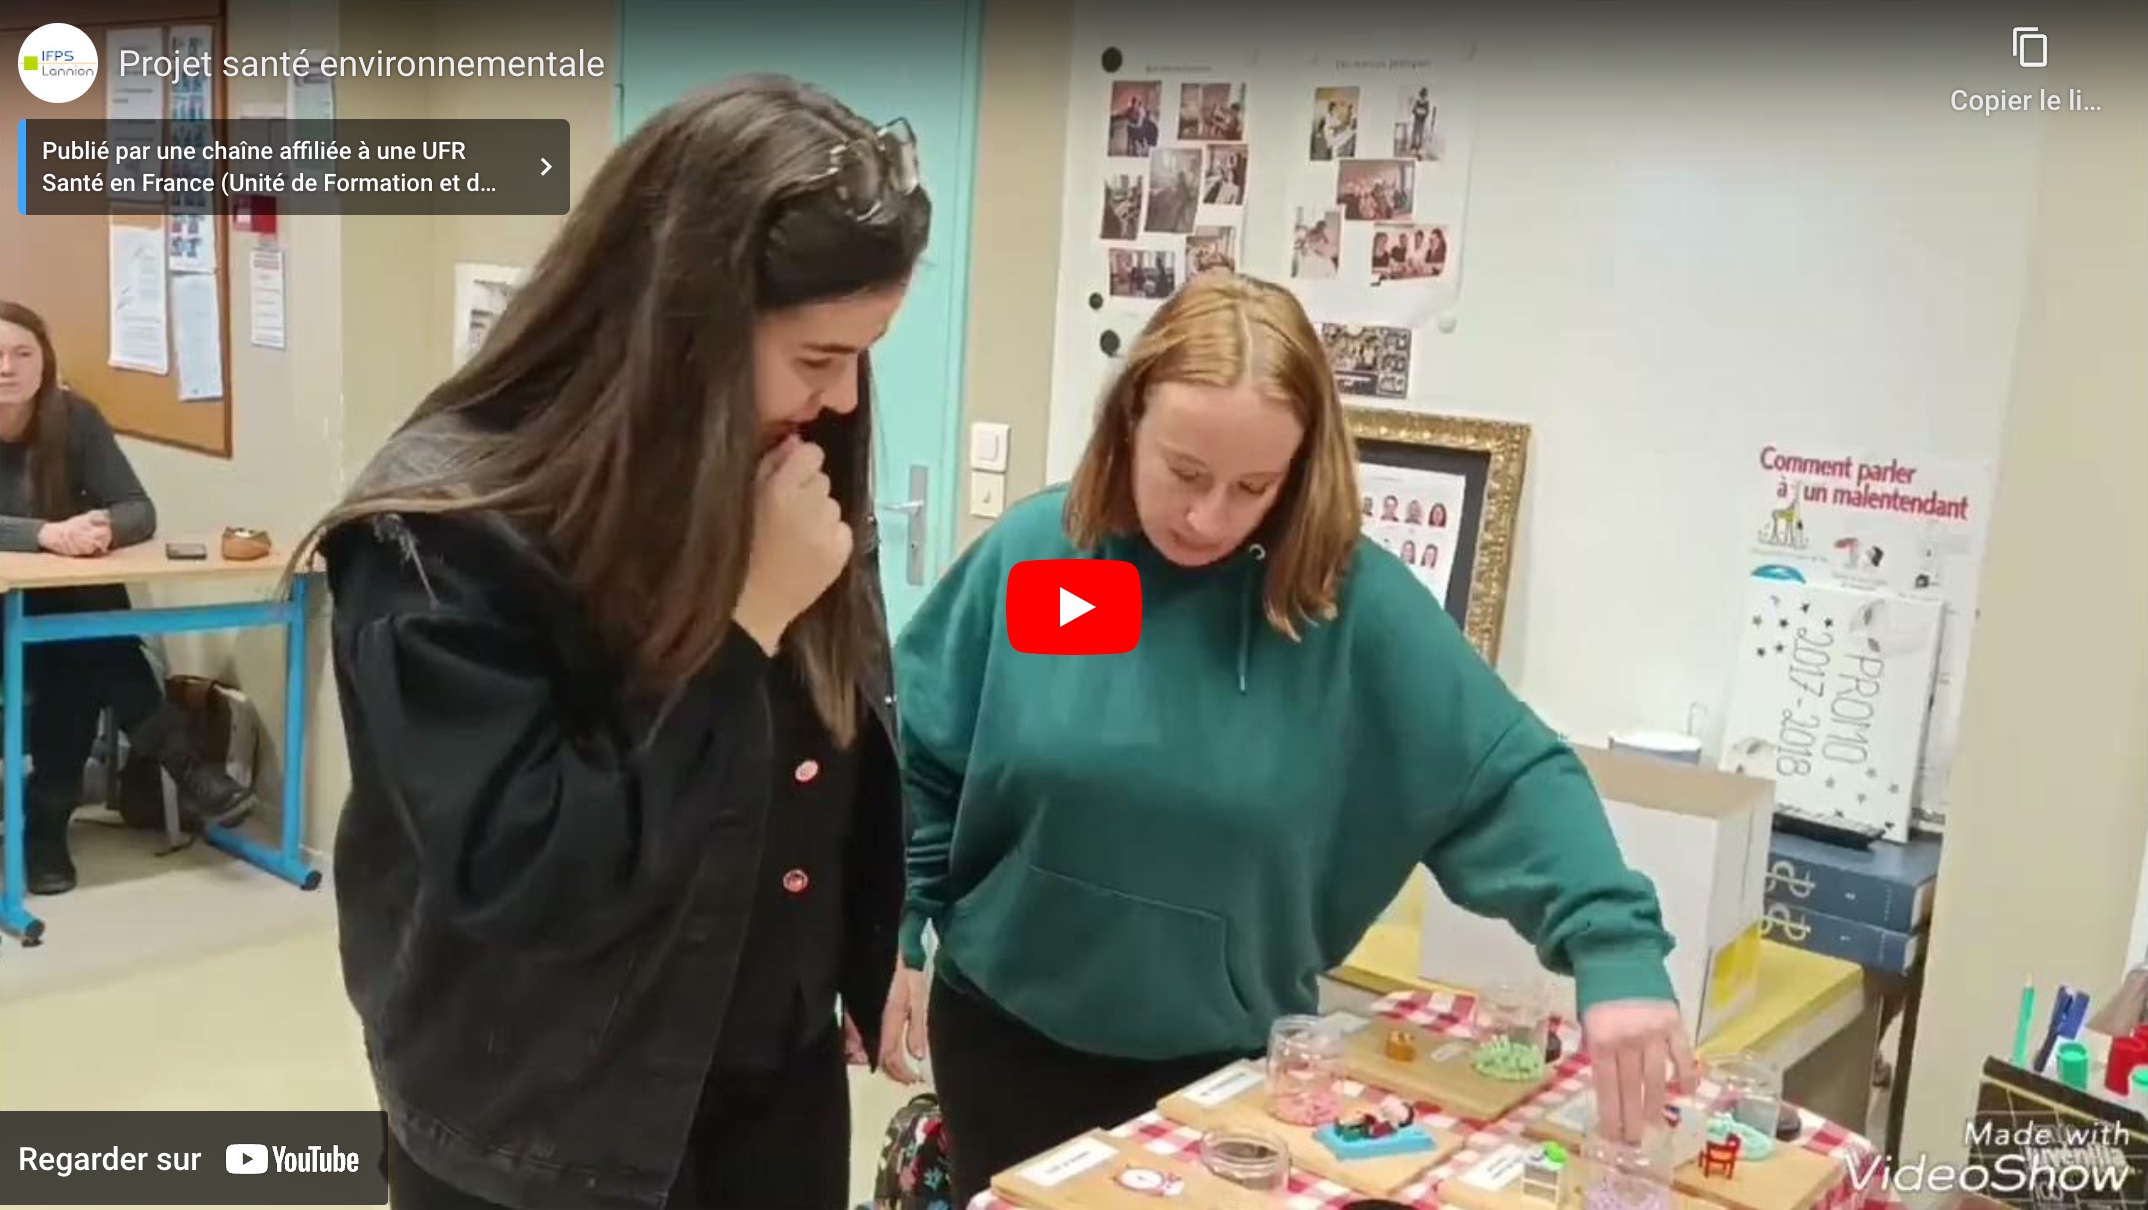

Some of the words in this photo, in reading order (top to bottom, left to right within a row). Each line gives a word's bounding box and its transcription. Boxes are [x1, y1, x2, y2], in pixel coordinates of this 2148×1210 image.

[1760, 446, 1853, 478] Comment
[1857, 458, 1917, 486] parler
[1777, 475, 1788, 498] à
[1803, 484, 1828, 503] un
[1832, 483, 1969, 520] malentendant
[1821, 653, 1885, 764] PROMO
